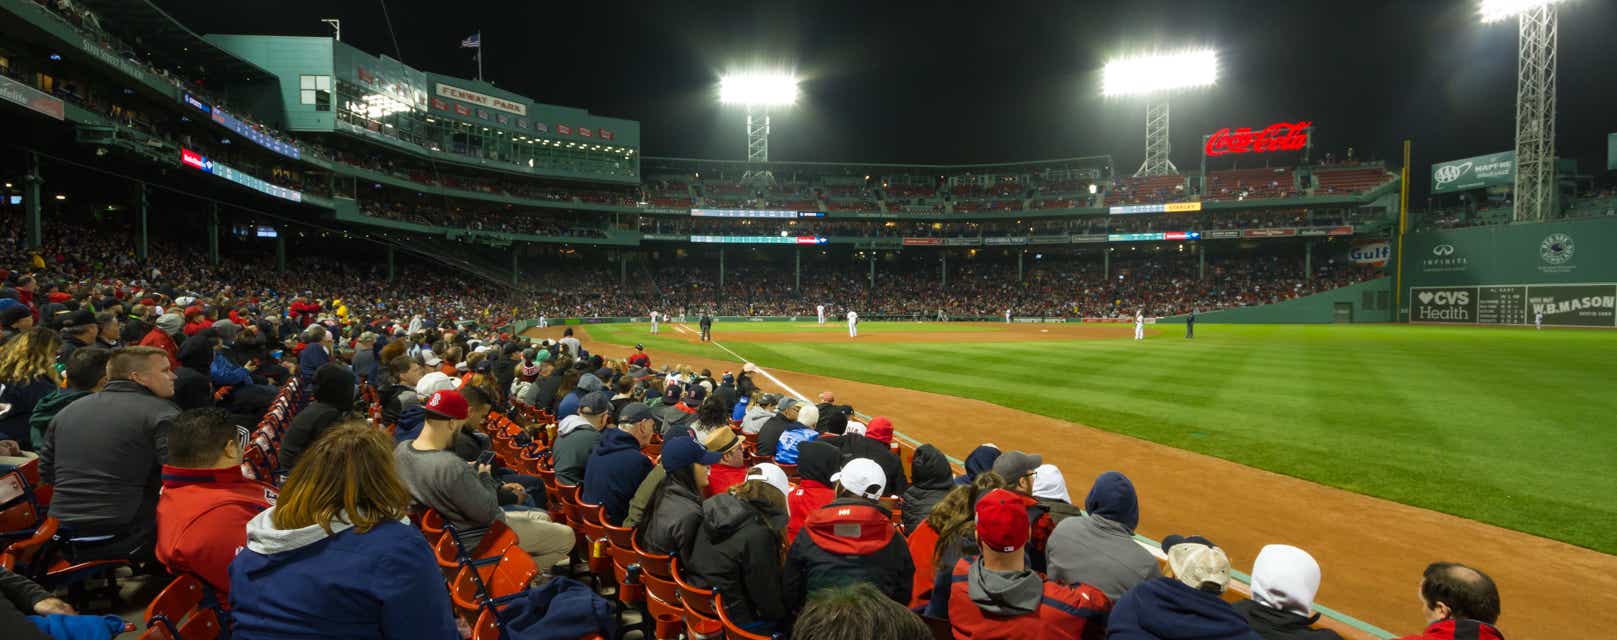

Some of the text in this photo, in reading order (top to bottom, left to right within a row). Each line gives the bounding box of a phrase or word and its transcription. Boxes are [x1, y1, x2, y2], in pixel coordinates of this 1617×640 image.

[442, 86, 521, 112] FENWAY PARK
[1205, 121, 1312, 156] Coca-Cola
[1351, 246, 1390, 260] Gulf
[1434, 291, 1470, 305] CVS
[1419, 306, 1469, 320] Health
